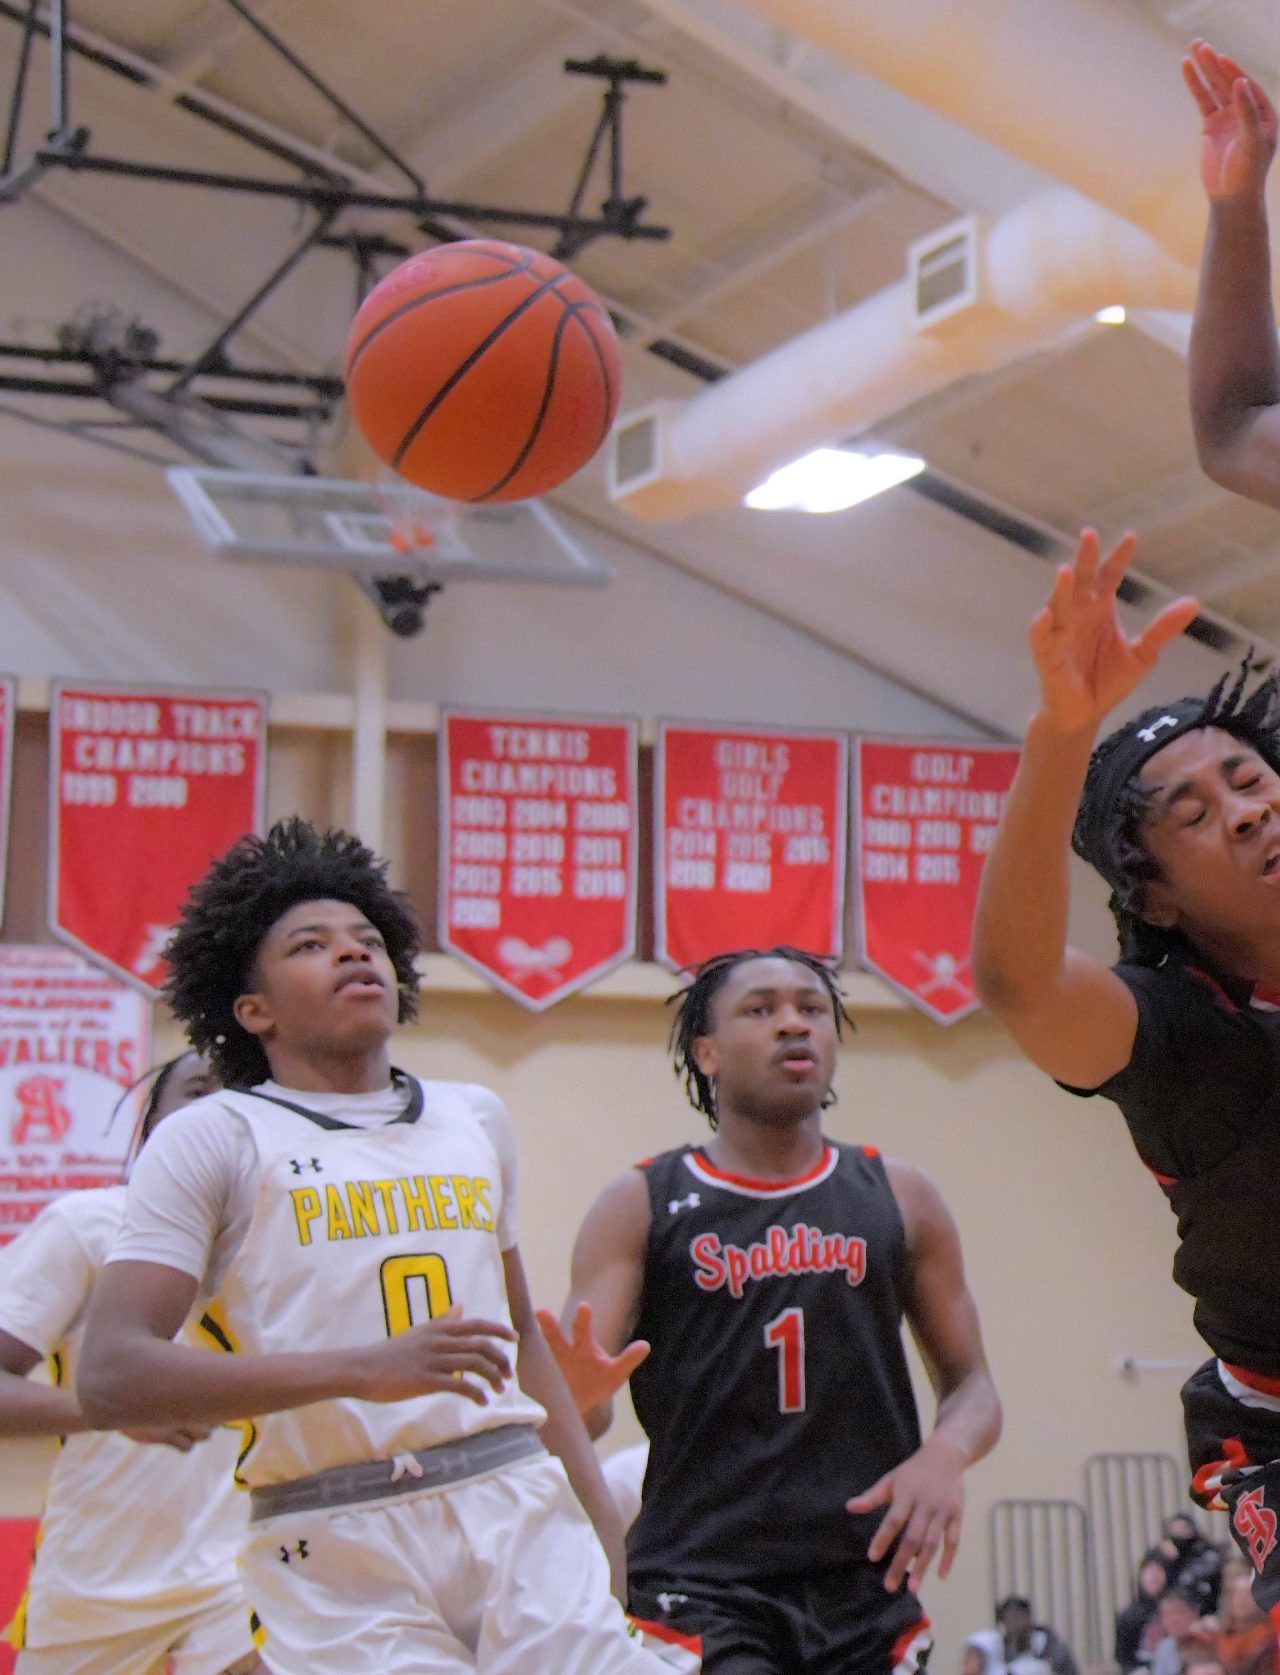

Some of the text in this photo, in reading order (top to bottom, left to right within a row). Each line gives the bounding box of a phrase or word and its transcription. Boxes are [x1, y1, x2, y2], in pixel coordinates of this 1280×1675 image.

[171, 704, 259, 741] TRACK
[74, 734, 246, 775] CHAMPIONS
[490, 726, 589, 762] TENNIS
[715, 739, 790, 773] GIRLS
[461, 759, 616, 798] CHAMPIONS
[721, 771, 783, 801] GOLF
[911, 753, 974, 784] GOLF
[678, 797, 824, 834] CHAMPIONS
[289, 1174, 496, 1246] PANTHERS
[690, 1223, 867, 1299] Spalding
[764, 1307, 806, 1414] 1
